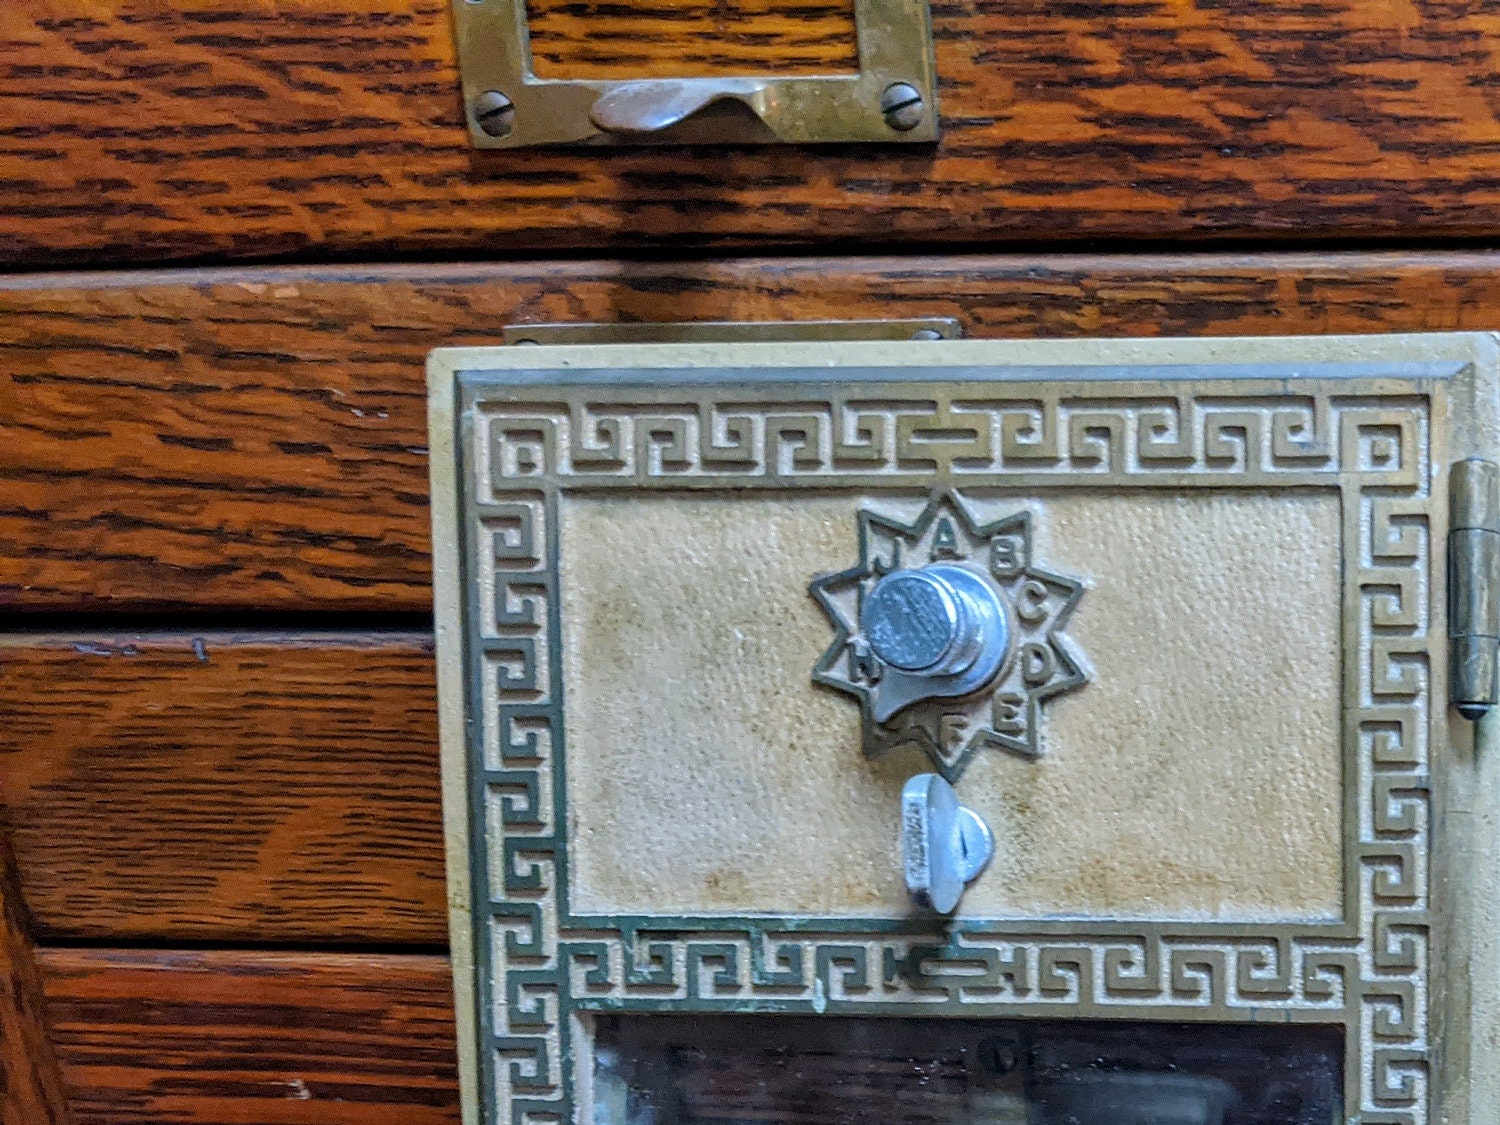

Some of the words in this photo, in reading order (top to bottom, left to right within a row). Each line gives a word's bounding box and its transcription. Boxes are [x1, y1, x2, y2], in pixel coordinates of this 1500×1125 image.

[873, 538, 902, 574] J
[931, 517, 966, 561] A
[991, 536, 1023, 577] B
[1017, 581, 1050, 622] C
[1023, 643, 1056, 687] D
[940, 713, 968, 752] F
[992, 693, 1025, 733] E
